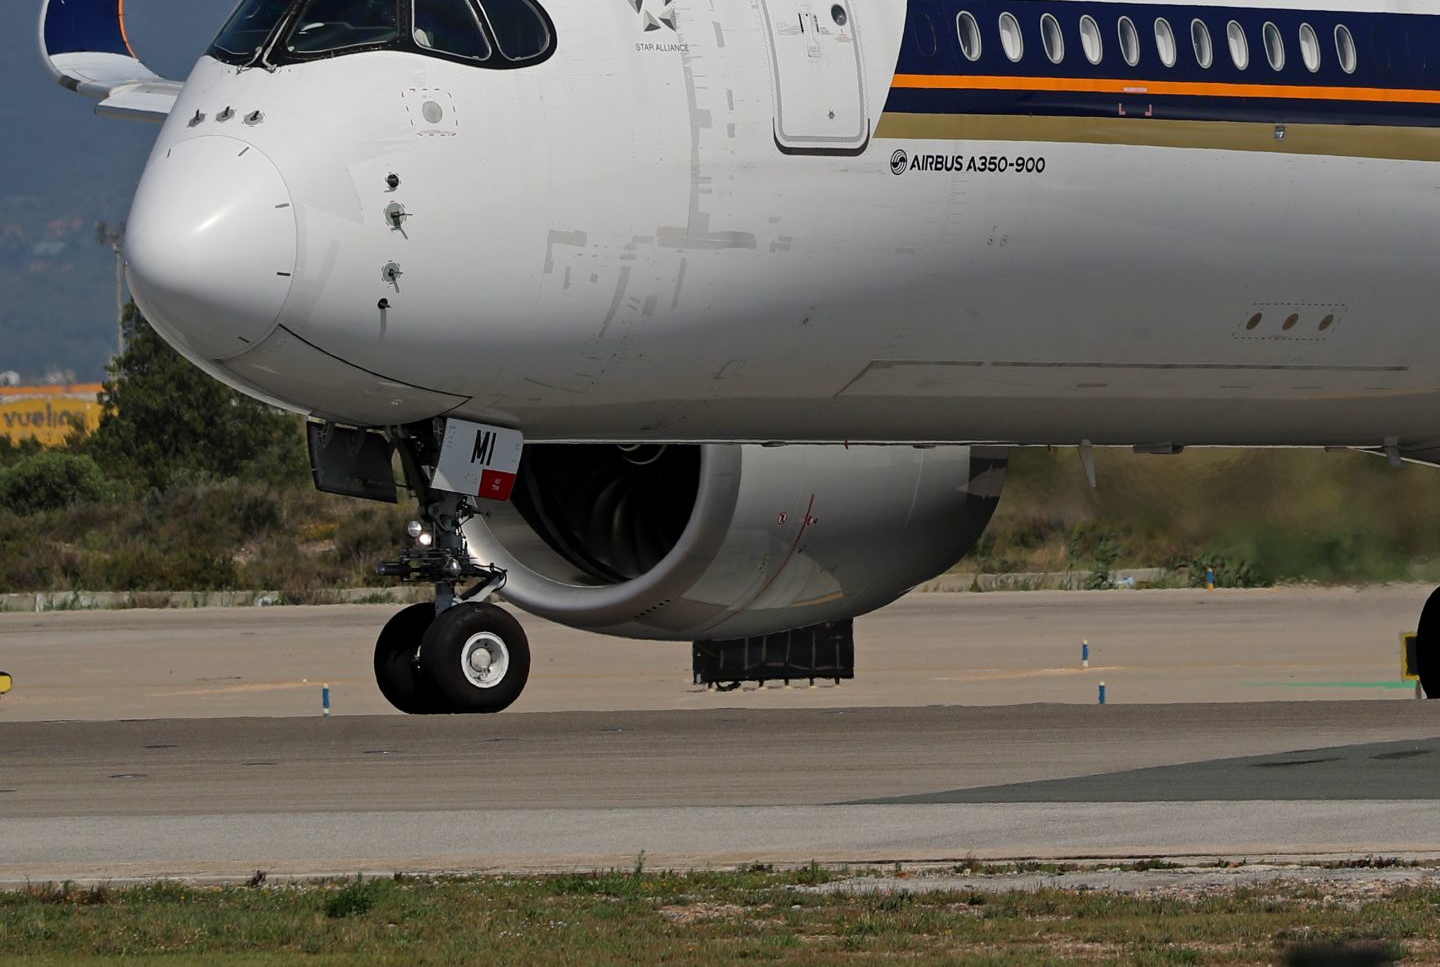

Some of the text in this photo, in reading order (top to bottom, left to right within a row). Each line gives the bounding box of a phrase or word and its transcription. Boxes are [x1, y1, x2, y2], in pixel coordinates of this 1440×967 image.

[635, 43, 689, 52] STAR ALLIANCE
[909, 154, 1046, 173] AIRBUS A350-900
[470, 429, 497, 466] MI
